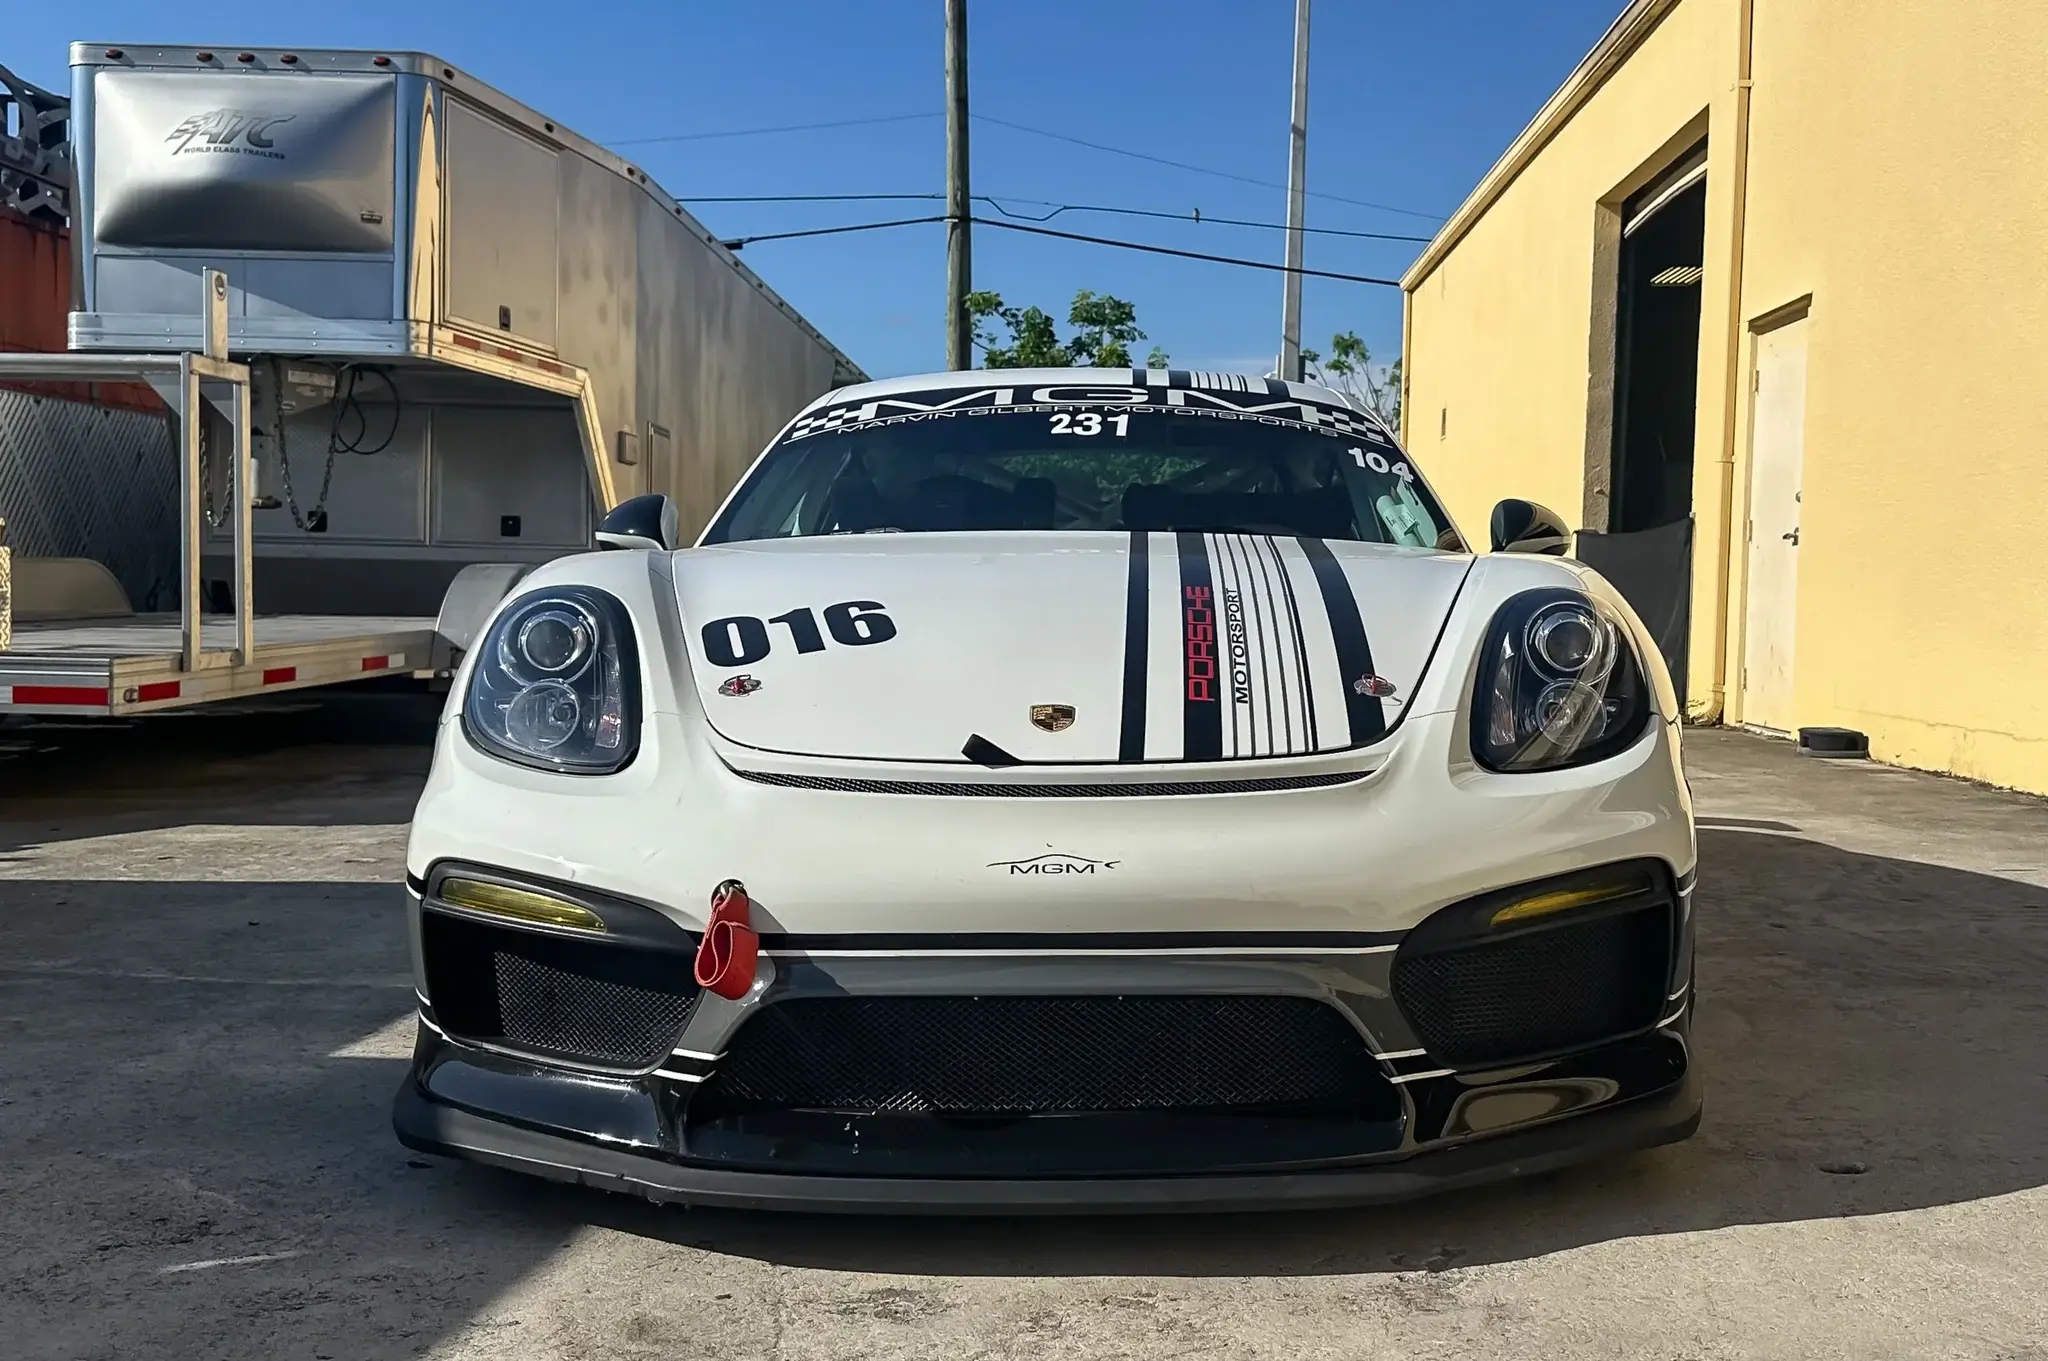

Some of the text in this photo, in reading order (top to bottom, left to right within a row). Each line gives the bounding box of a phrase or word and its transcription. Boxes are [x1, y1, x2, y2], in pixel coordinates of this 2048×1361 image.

[199, 108, 297, 148] ATC
[184, 146, 285, 160] WORLD CLASS TRAILERS
[837, 404, 1339, 438] MARVIN GILBERT MOTORSPORTS
[857, 386, 1319, 423] MGM
[1048, 412, 1129, 437] 231
[1347, 446, 1415, 483] 104
[701, 600, 898, 667] 016
[1185, 586, 1216, 702] PORSCHE
[1225, 587, 1250, 705] MOTORSPORT
[1009, 863, 1096, 875] MGM
